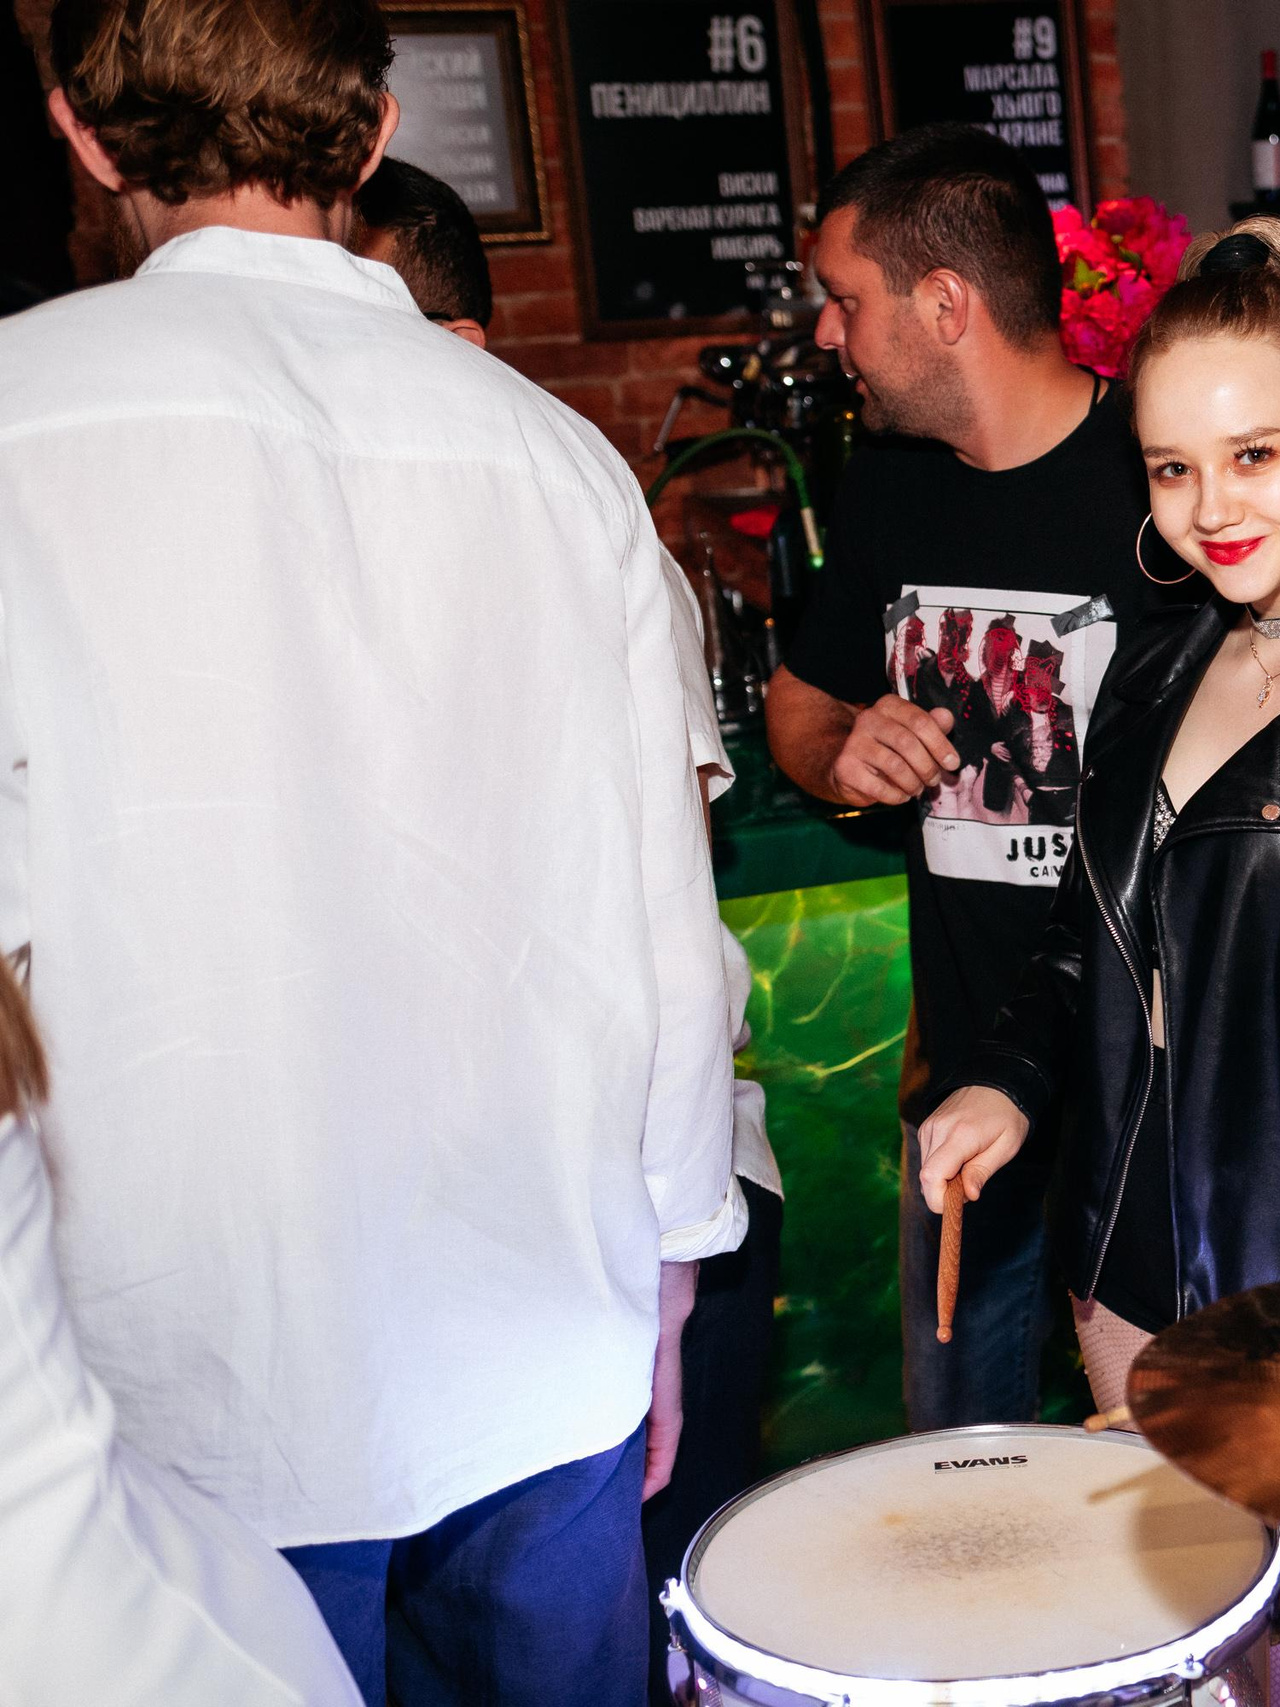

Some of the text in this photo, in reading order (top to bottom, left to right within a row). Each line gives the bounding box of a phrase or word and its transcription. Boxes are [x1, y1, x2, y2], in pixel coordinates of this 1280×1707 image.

[707, 14, 767, 73] #6
[1012, 16, 1057, 60] #9
[963, 63, 1060, 92] МАРСАЛА
[590, 80, 771, 119] ПЕНИЦИЛЛИН
[991, 91, 1062, 119] ХЬЮГО
[717, 172, 779, 197] ВИСКИ
[711, 234, 784, 260] ИМБИРЬ
[1006, 832, 1074, 862] JUS
[934, 1455, 1028, 1470] EVANS
